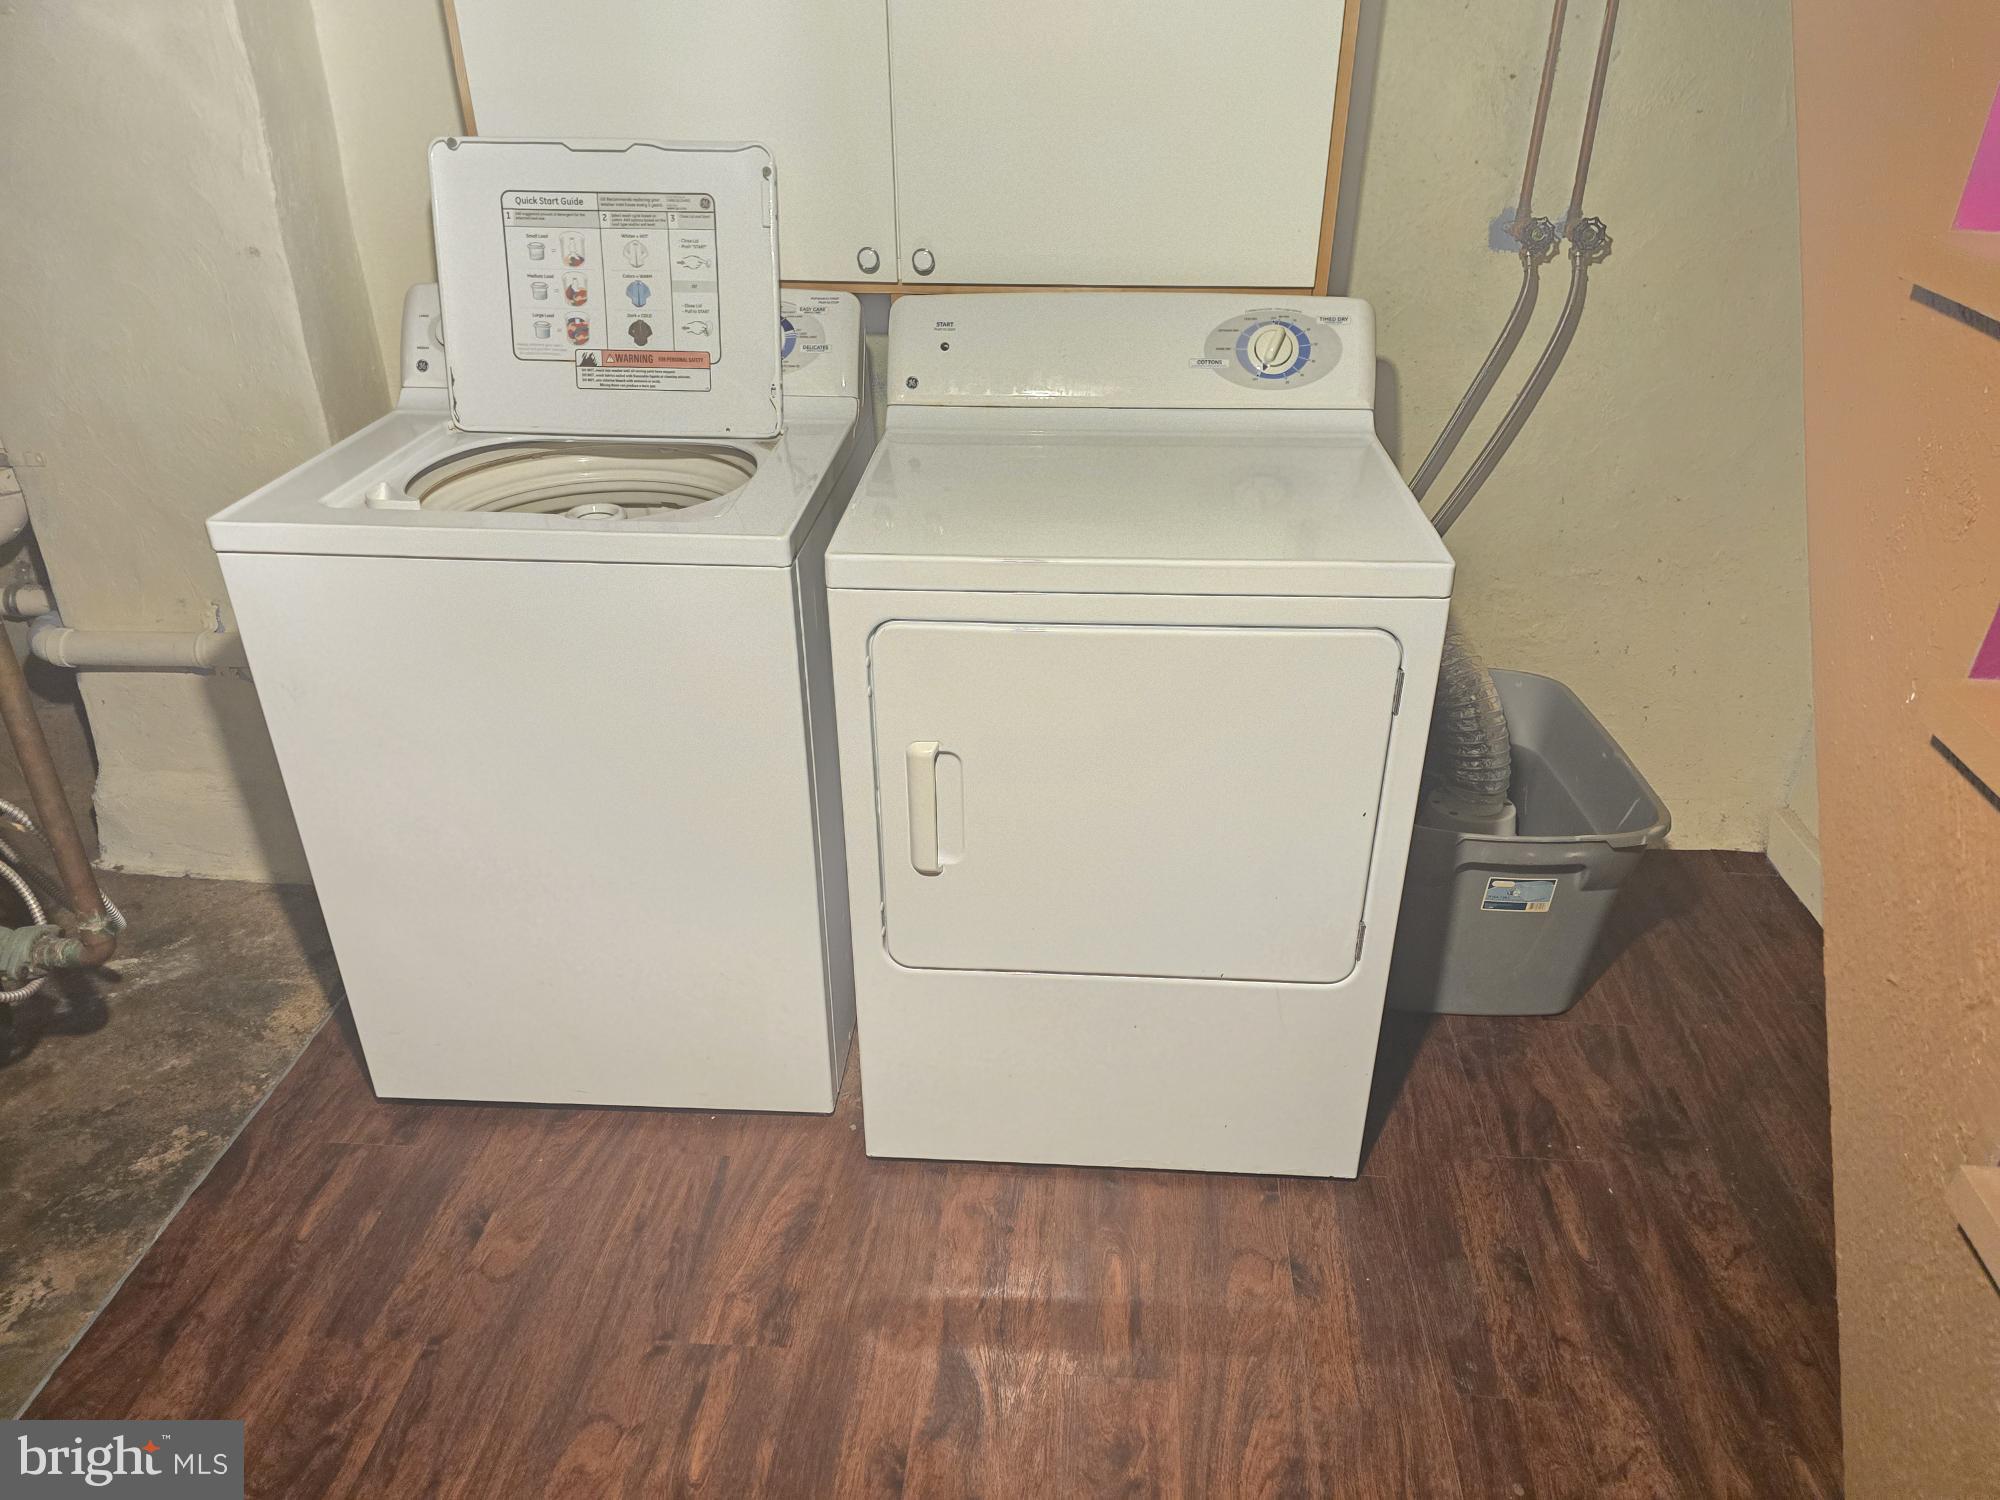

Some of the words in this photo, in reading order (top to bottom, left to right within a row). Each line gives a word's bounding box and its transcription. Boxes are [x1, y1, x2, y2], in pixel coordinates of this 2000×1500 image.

[515, 196, 538, 206] Quick
[539, 197, 559, 205] Start
[561, 197, 584, 206] Guide
[507, 211, 511, 219] 1
[602, 213, 607, 221] 2
[670, 214, 675, 222] 3
[615, 354, 654, 364] WARNING
